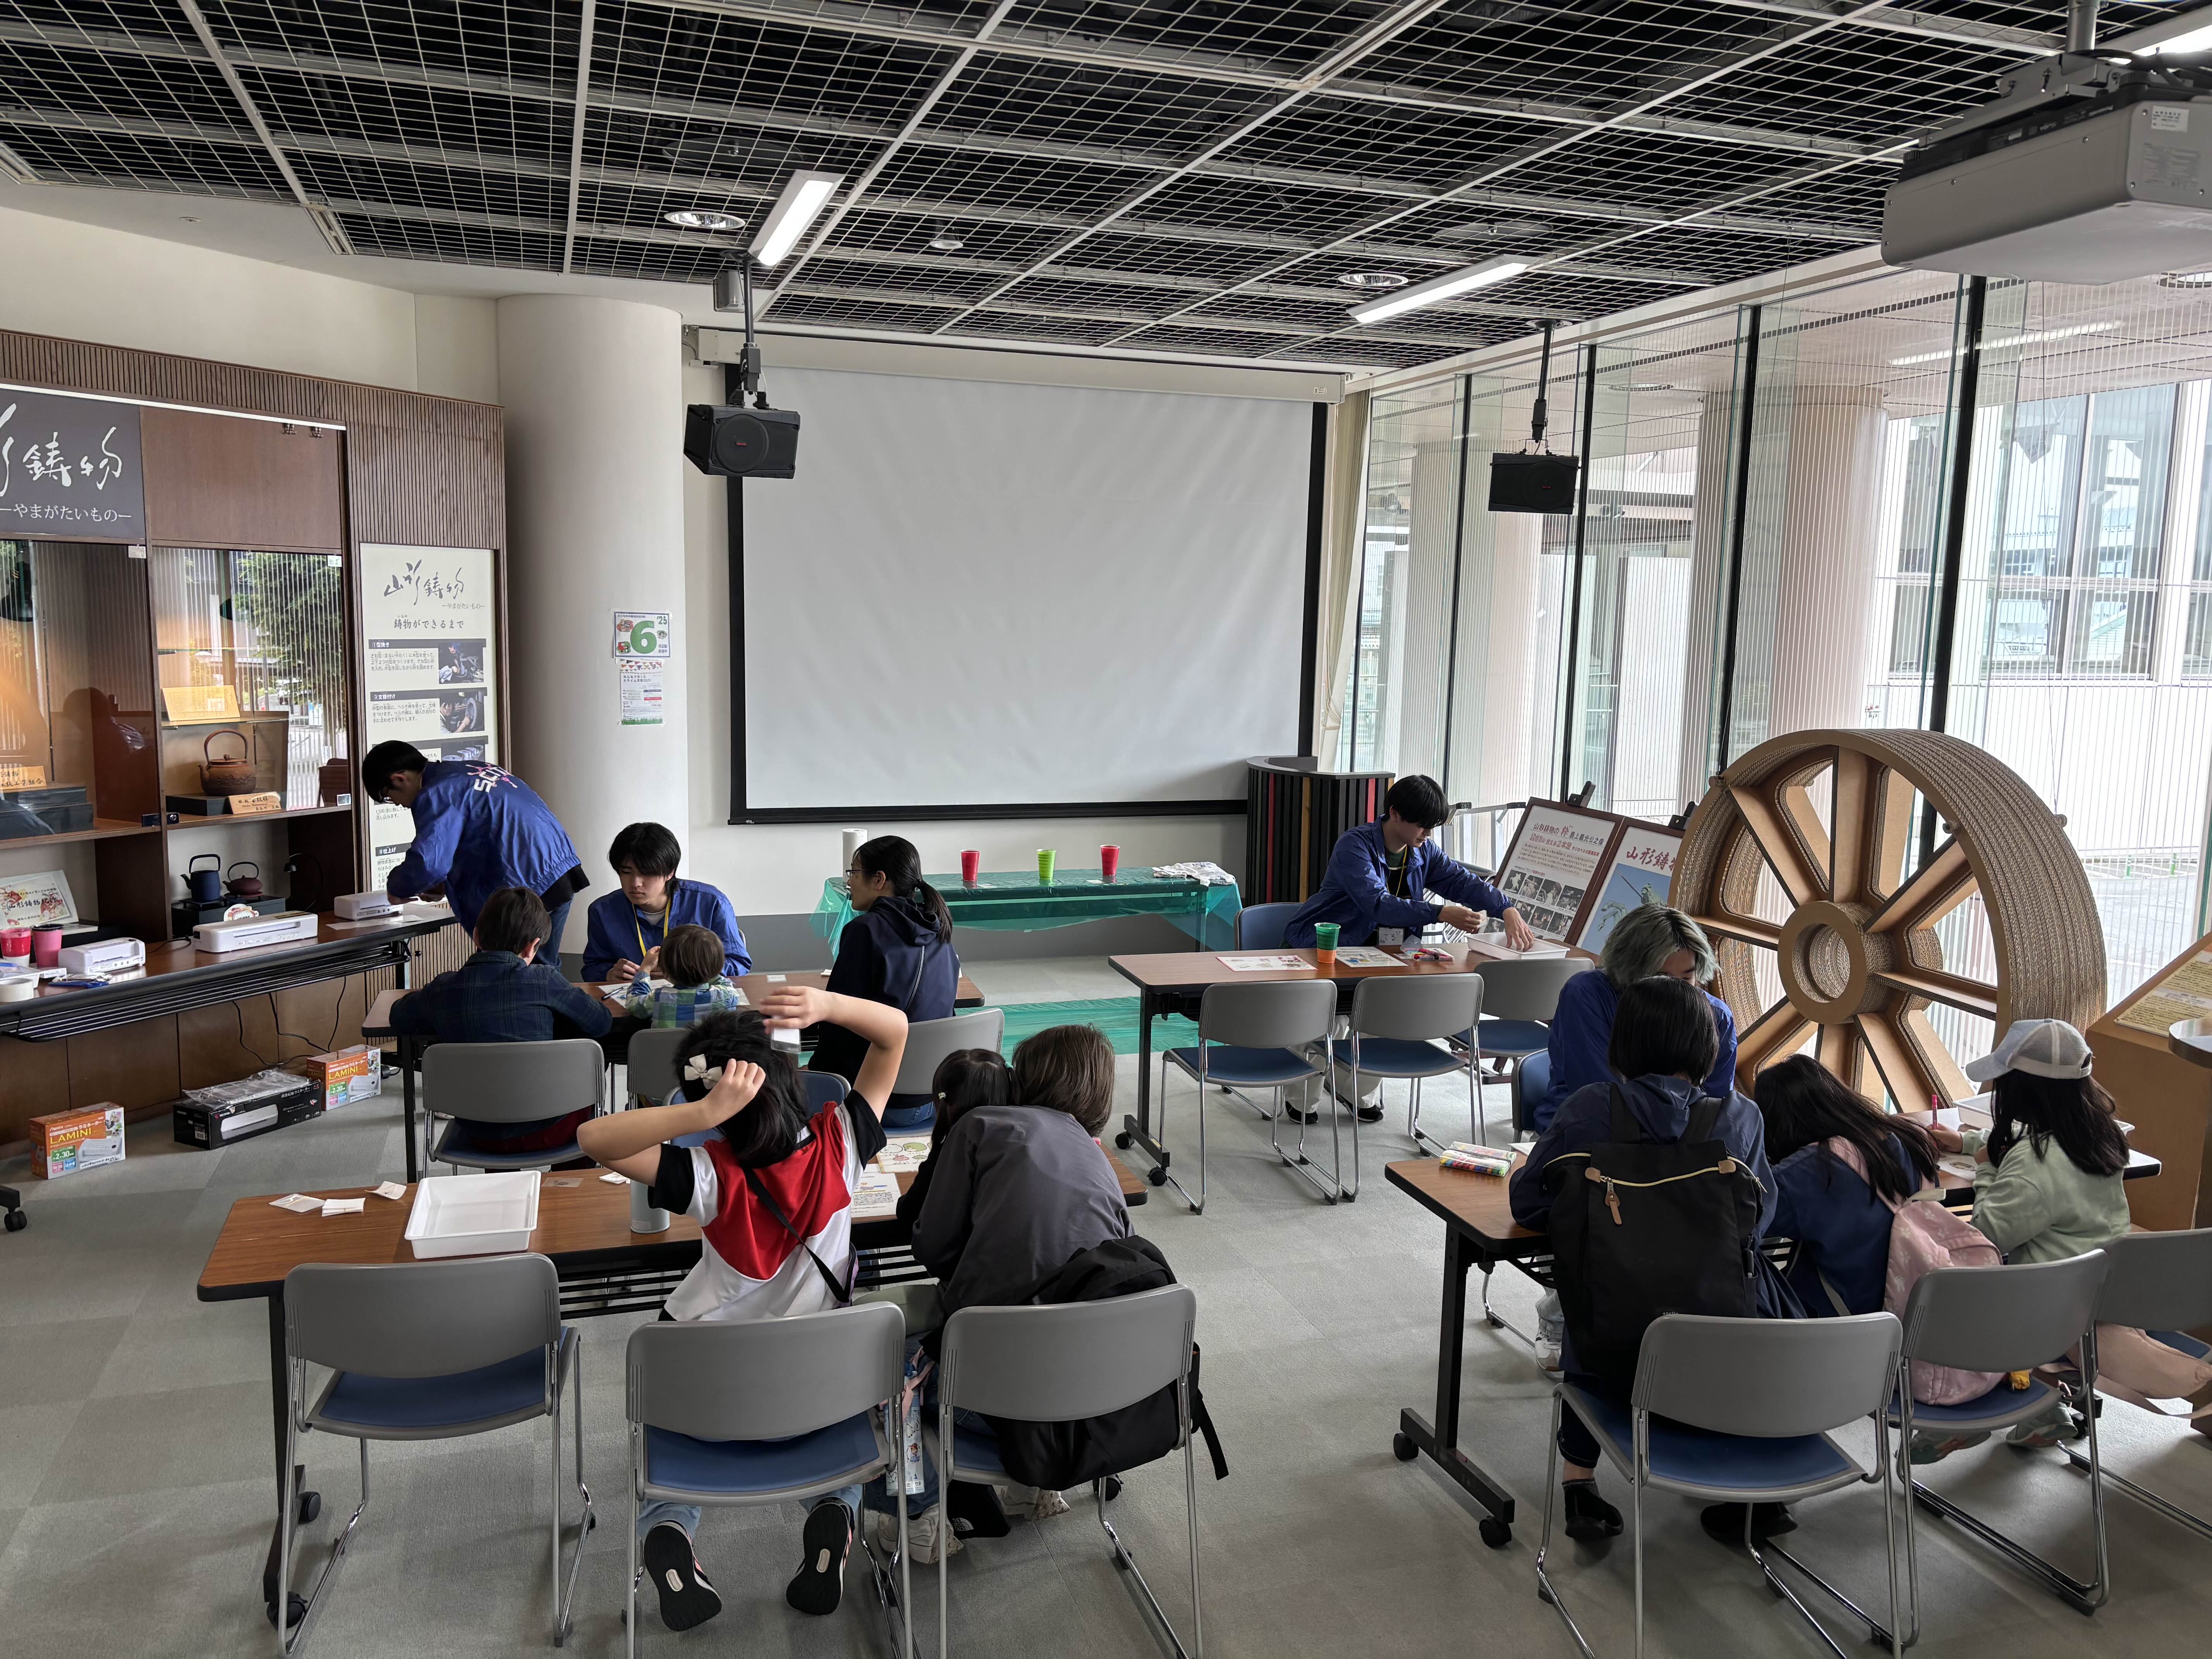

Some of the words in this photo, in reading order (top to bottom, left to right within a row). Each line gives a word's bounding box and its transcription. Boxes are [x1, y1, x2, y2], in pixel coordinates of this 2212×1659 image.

[394, 619, 464, 629] 鋳物ができるまで
[630, 620, 657, 654] 6
[329, 1066, 358, 1080] LAMINI
[50, 1128, 92, 1144] LAMINI
